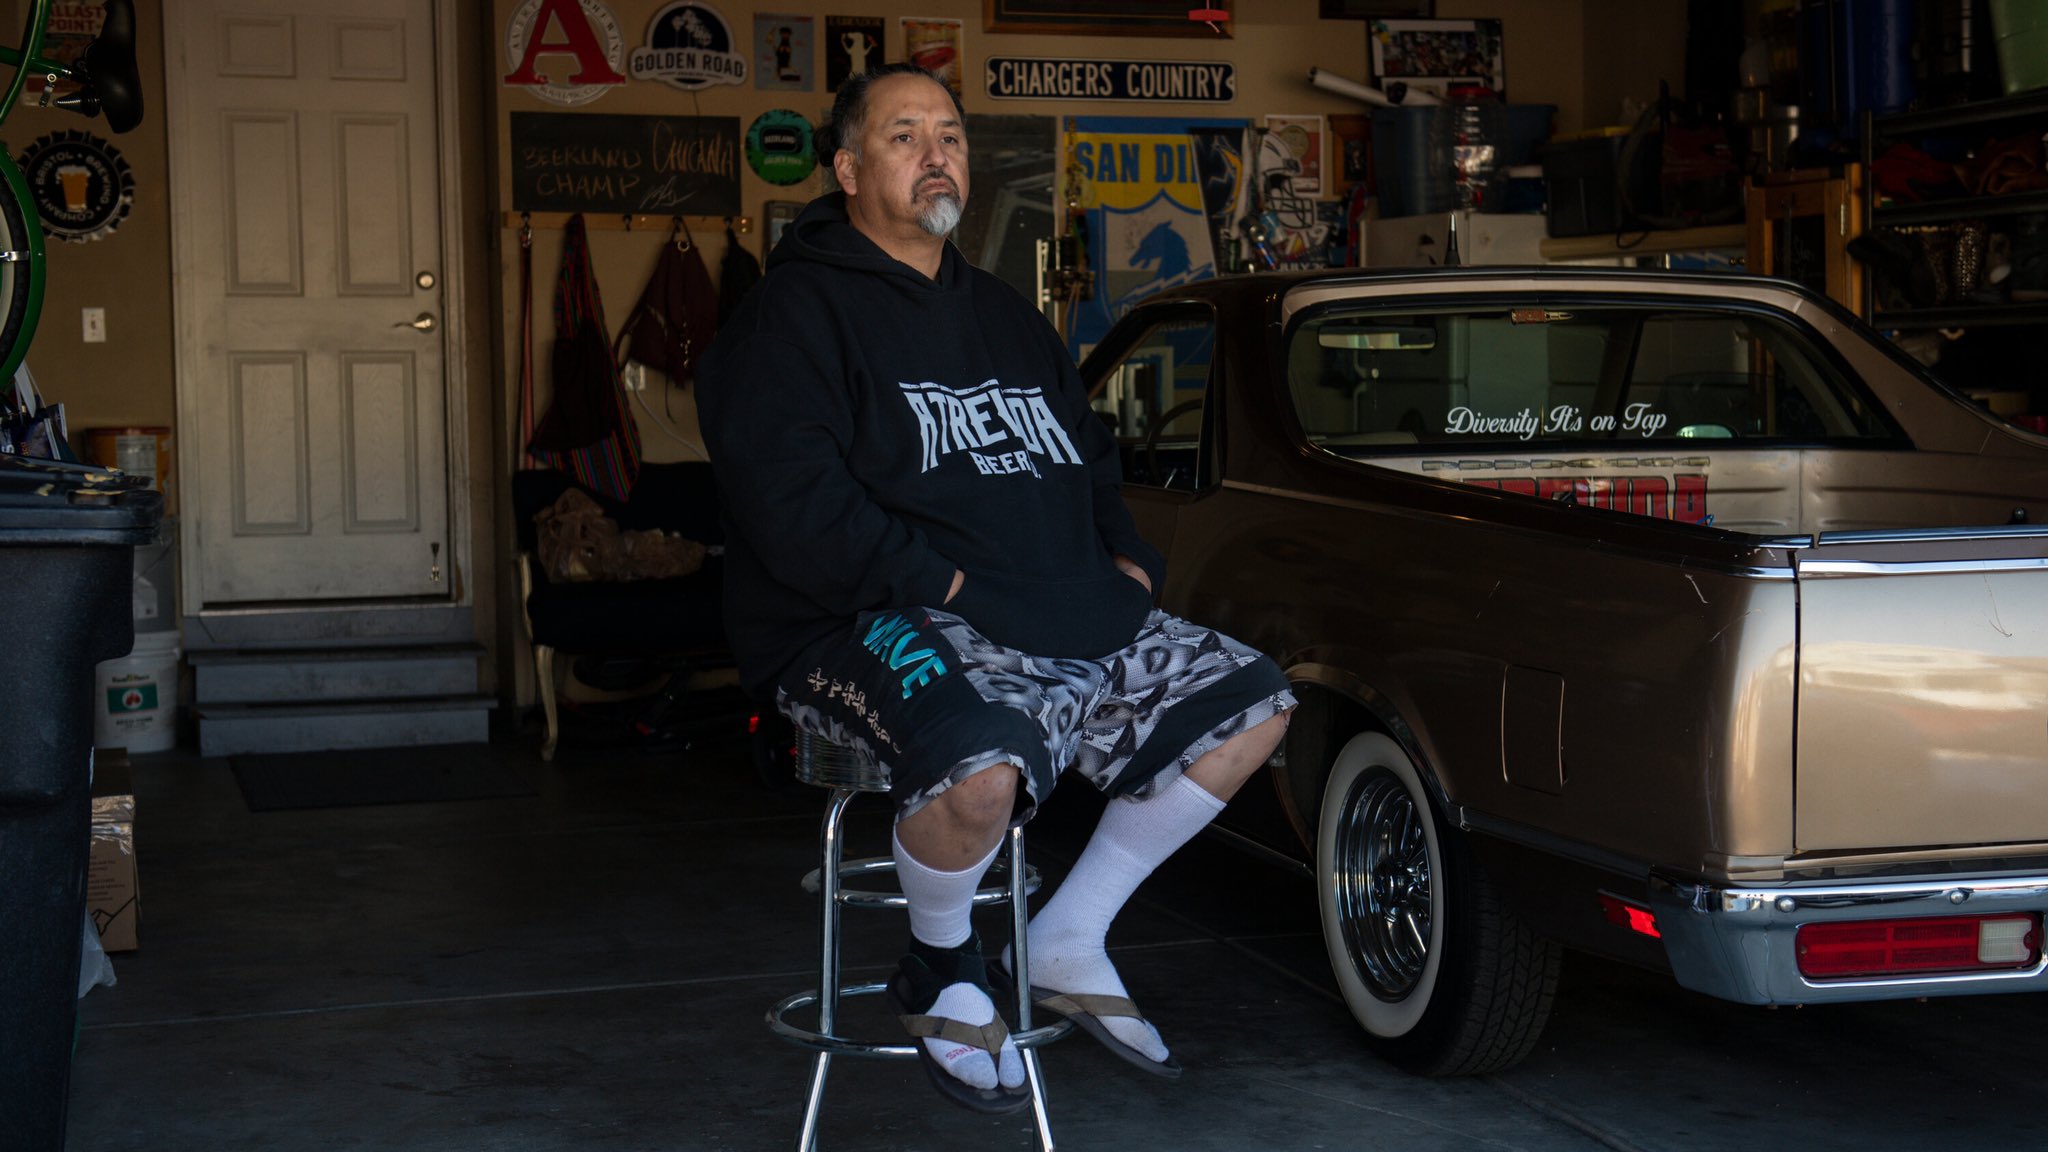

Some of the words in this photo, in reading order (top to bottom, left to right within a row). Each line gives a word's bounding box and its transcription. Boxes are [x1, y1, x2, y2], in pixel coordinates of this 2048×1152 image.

[50, 5, 102, 18] ALLAST
[47, 19, 95, 32] POINT
[634, 53, 696, 73] GOLDEN
[703, 54, 743, 77] ROAD
[1000, 60, 1114, 97] CHARGERS
[1126, 62, 1227, 99] COUNTRY
[523, 145, 642, 170] BEERLAND
[1076, 142, 1140, 183] SAN
[1154, 143, 1200, 183] DI
[35, 152, 74, 187] BRISTOL
[85, 155, 111, 205] BREWING
[535, 172, 641, 199] CHAMP
[1444, 406, 1539, 441] Diversity
[1544, 404, 1583, 433] It's
[1590, 415, 1617, 432] on
[1622, 402, 1668, 439] Tap
[968, 450, 1031, 475] BEER
